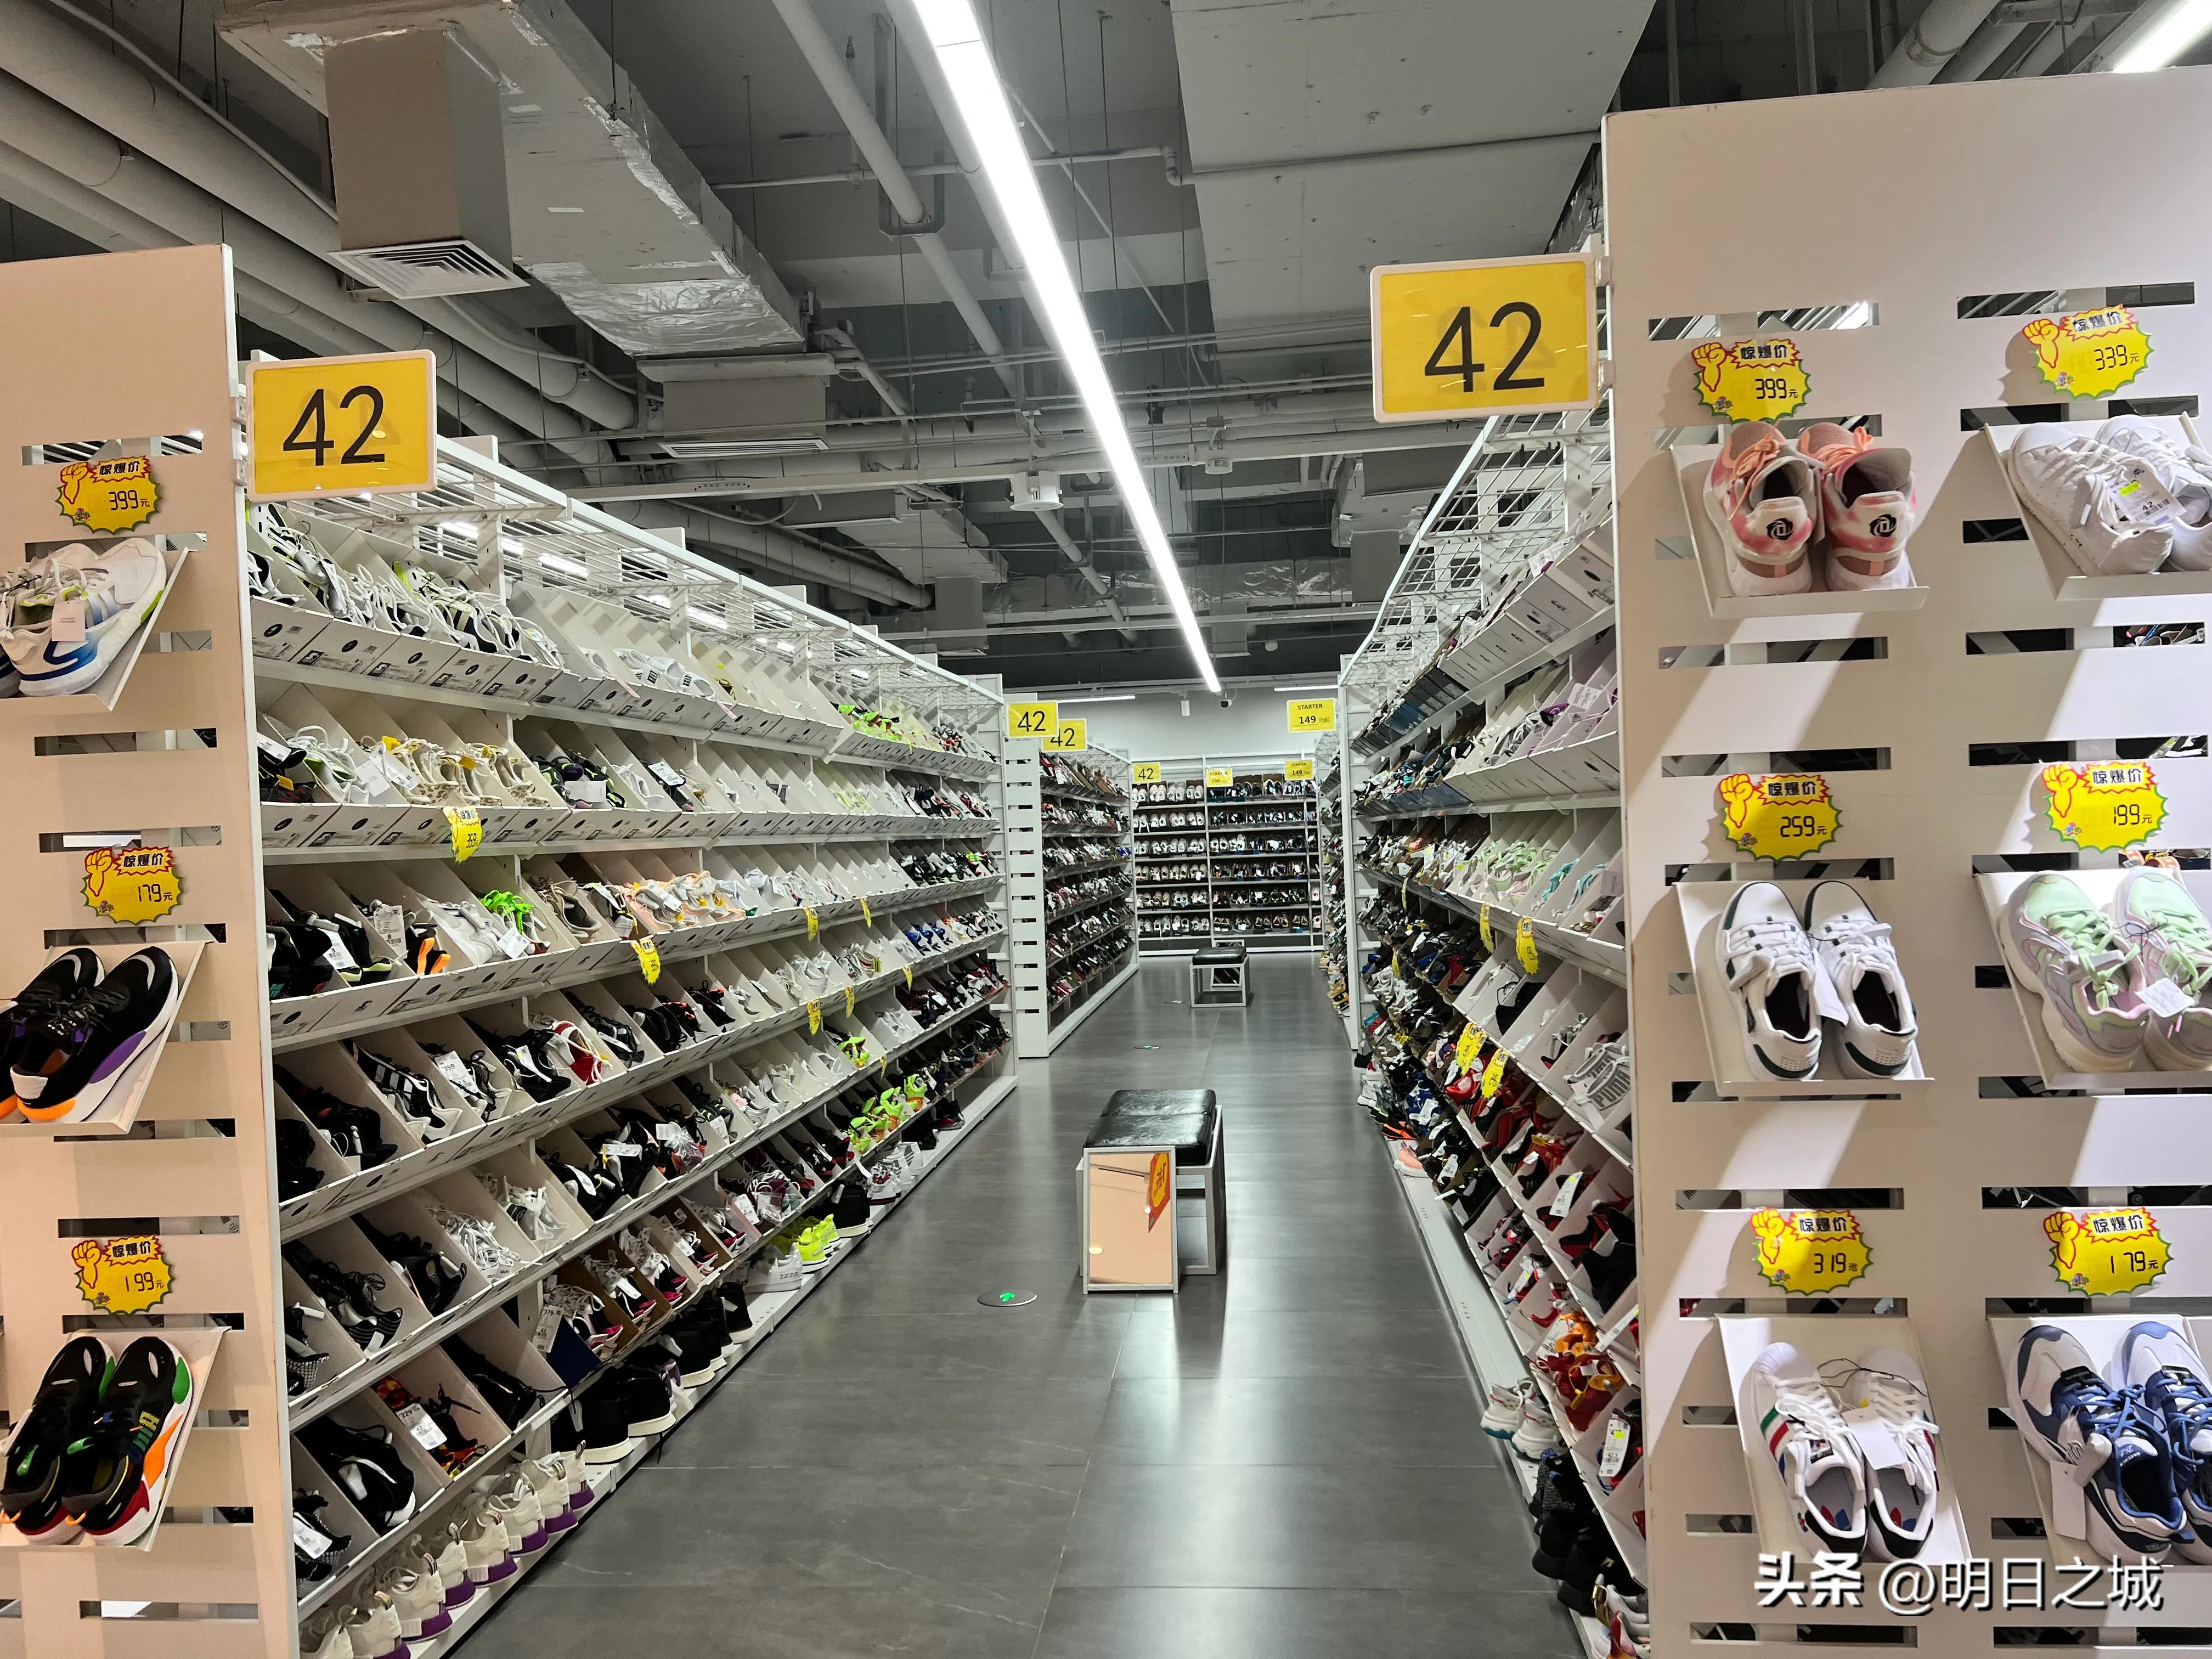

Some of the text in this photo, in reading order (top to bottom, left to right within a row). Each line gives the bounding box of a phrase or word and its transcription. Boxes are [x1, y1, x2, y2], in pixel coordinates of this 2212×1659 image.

[2072, 311, 2123, 331] 惊爆价
[1425, 301, 1545, 393] 42
[1740, 345, 1787, 359] 惊爆价
[283, 385, 385, 466] 42
[99, 460, 140, 475] 惊爆价
[2142, 501, 2153, 511] 42
[1017, 710, 1046, 732] 42
[1299, 715, 1317, 724] 149
[1050, 727, 1075, 747] 42
[1138, 768, 1154, 780] 42
[2092, 769, 2142, 784] 惊爆价
[1767, 781, 1816, 796] 惊爆价
[123, 853, 164, 867] 惊爆价
[1592, 1068, 1630, 1108] PUMA
[1799, 1217, 1847, 1232] 惊爆价
[2092, 1215, 2143, 1233] 惊爆价
[112, 1240, 151, 1258] 惊爆价
